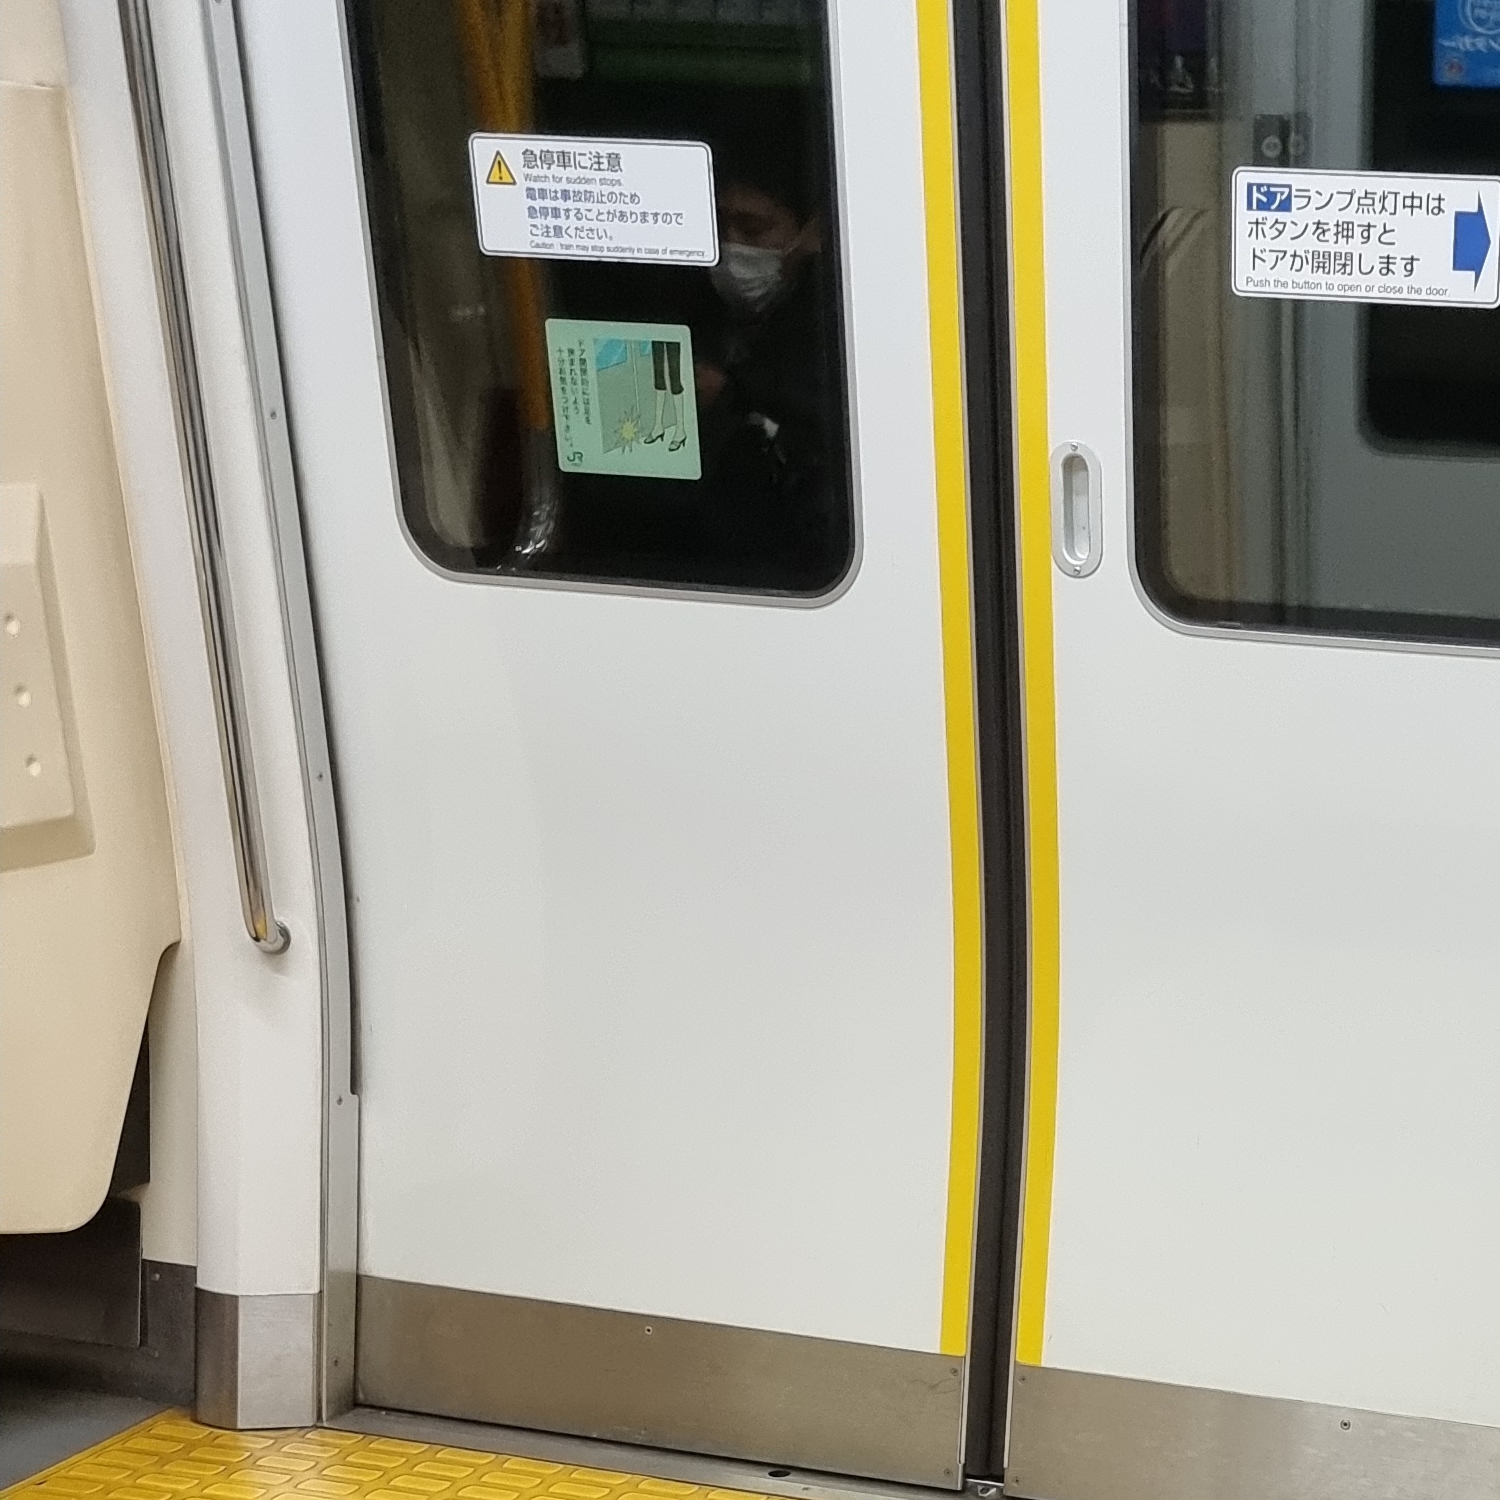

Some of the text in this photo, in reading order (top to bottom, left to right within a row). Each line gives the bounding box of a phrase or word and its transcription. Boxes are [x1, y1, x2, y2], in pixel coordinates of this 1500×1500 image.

[522, 149, 623, 173] 急停車に注意
[523, 173, 551, 184] Watch
[551, 174, 564, 185] for
[565, 175, 597, 186] sudden
[525, 186, 641, 205] 電車は事故防止のため
[1251, 184, 1446, 217] ドアランプ点灯中は
[527, 205, 684, 226] 急停車することがありますので
[529, 223, 614, 241] ご注意ください。
[1248, 217, 1397, 246] ボタンを押すと
[1251, 248, 1421, 278] ドアが開閉します
[1245, 276, 1271, 288] Push
[1273, 278, 1289, 289] the
[1291, 279, 1322, 290] button
[1325, 280, 1334, 291] to
[1337, 283, 1362, 293] open
[1364, 283, 1375, 292] or
[1378, 283, 1403, 294] close
[1406, 285, 1423, 295] the
